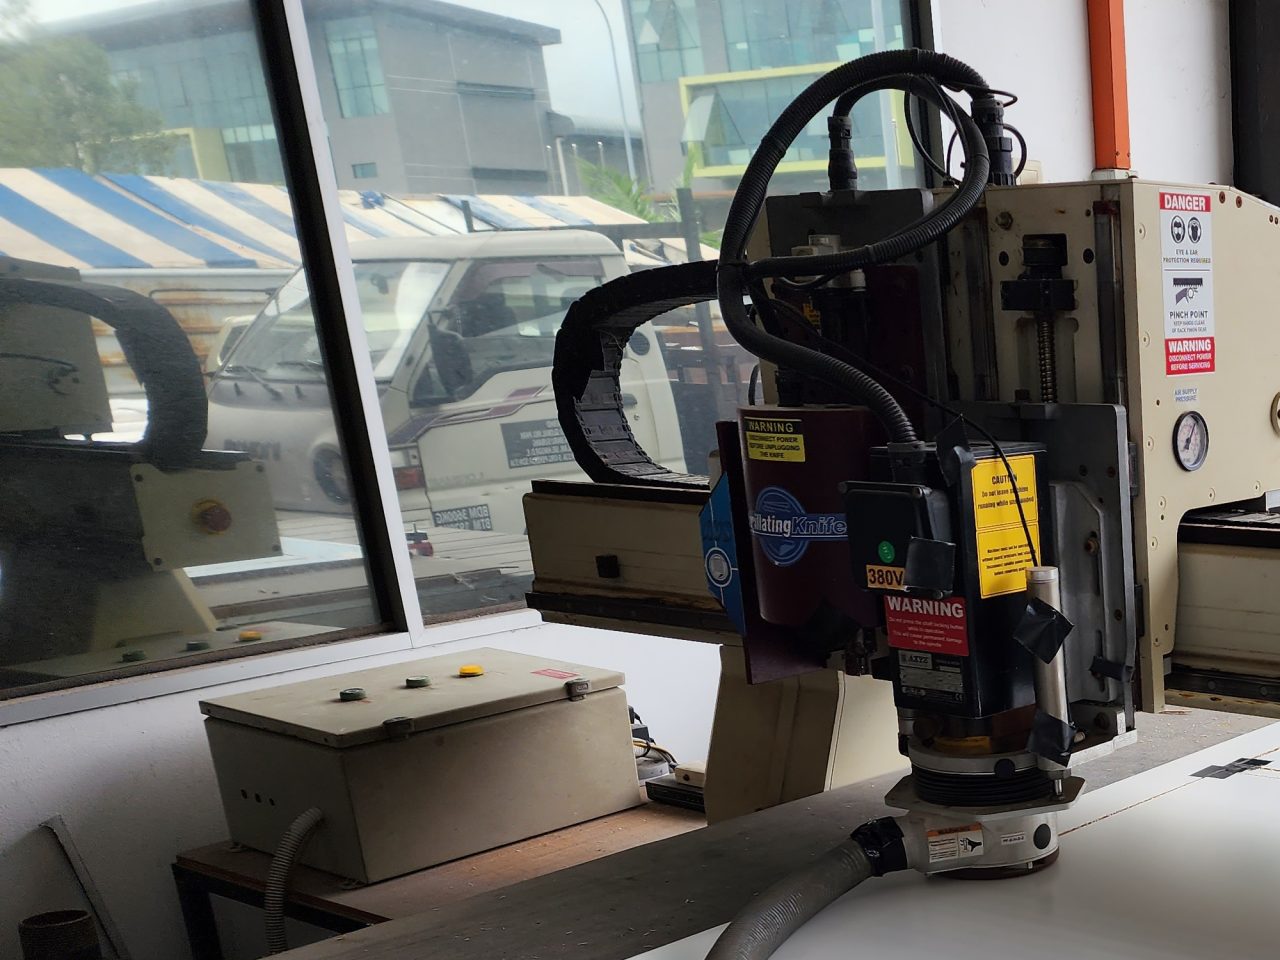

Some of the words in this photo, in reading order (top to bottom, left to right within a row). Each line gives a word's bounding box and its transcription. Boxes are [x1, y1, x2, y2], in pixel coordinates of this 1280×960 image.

[1164, 194, 1206, 211] DANGER
[1169, 311, 1189, 319] PINCH
[1190, 310, 1208, 319] POINT
[1168, 339, 1212, 353] WARNING
[1169, 354, 1196, 362] DISCONNECT
[749, 421, 794, 432] WARNING
[868, 568, 904, 586] 380V
[887, 595, 965, 618] WARNING
